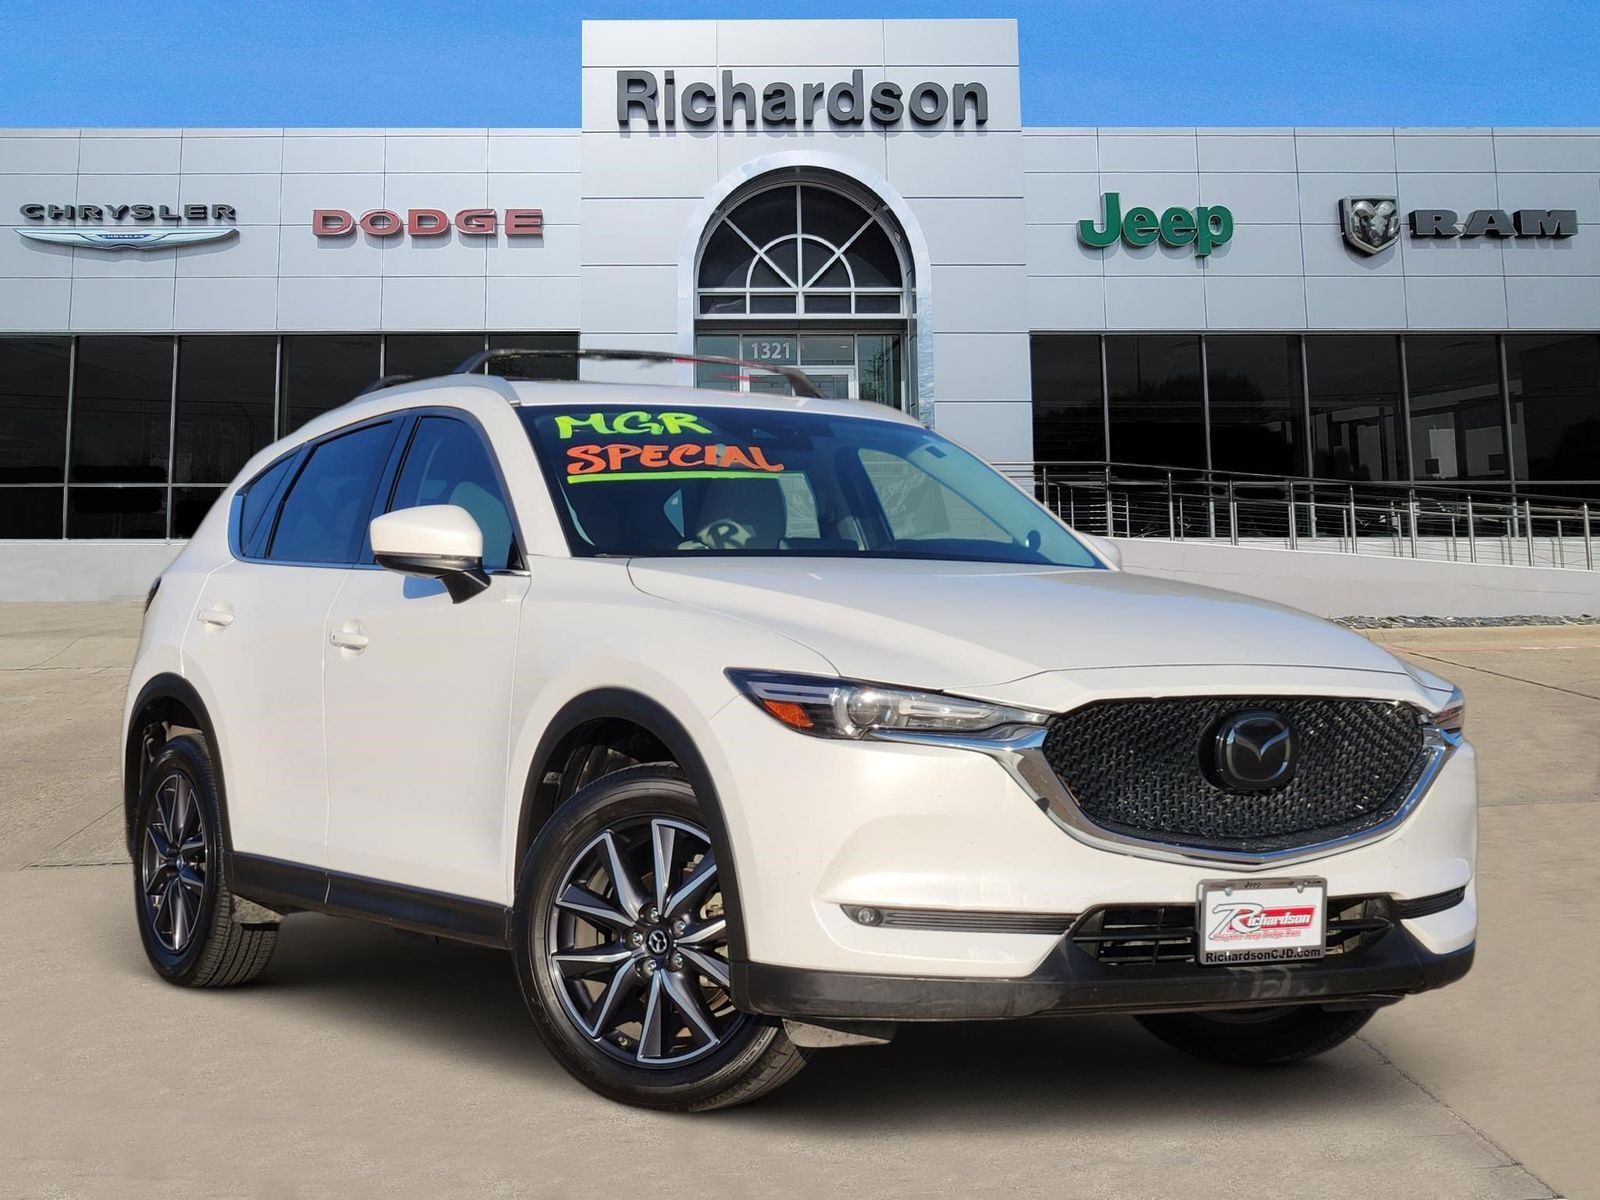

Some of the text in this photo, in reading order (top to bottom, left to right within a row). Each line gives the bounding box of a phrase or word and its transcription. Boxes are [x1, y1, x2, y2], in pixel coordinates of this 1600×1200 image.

[617, 69, 988, 126] Richardson
[20, 203, 237, 220] CHRYSLER
[312, 208, 543, 236] DODGE
[1077, 192, 1234, 257] Jeep
[1409, 209, 1578, 238] RAM
[751, 342, 790, 359] 1321
[555, 411, 712, 438] MGR
[566, 444, 784, 474] SPECIAL
[1208, 903, 1311, 940] Richardson
[1205, 948, 1321, 963] RichardsonCJD.com
